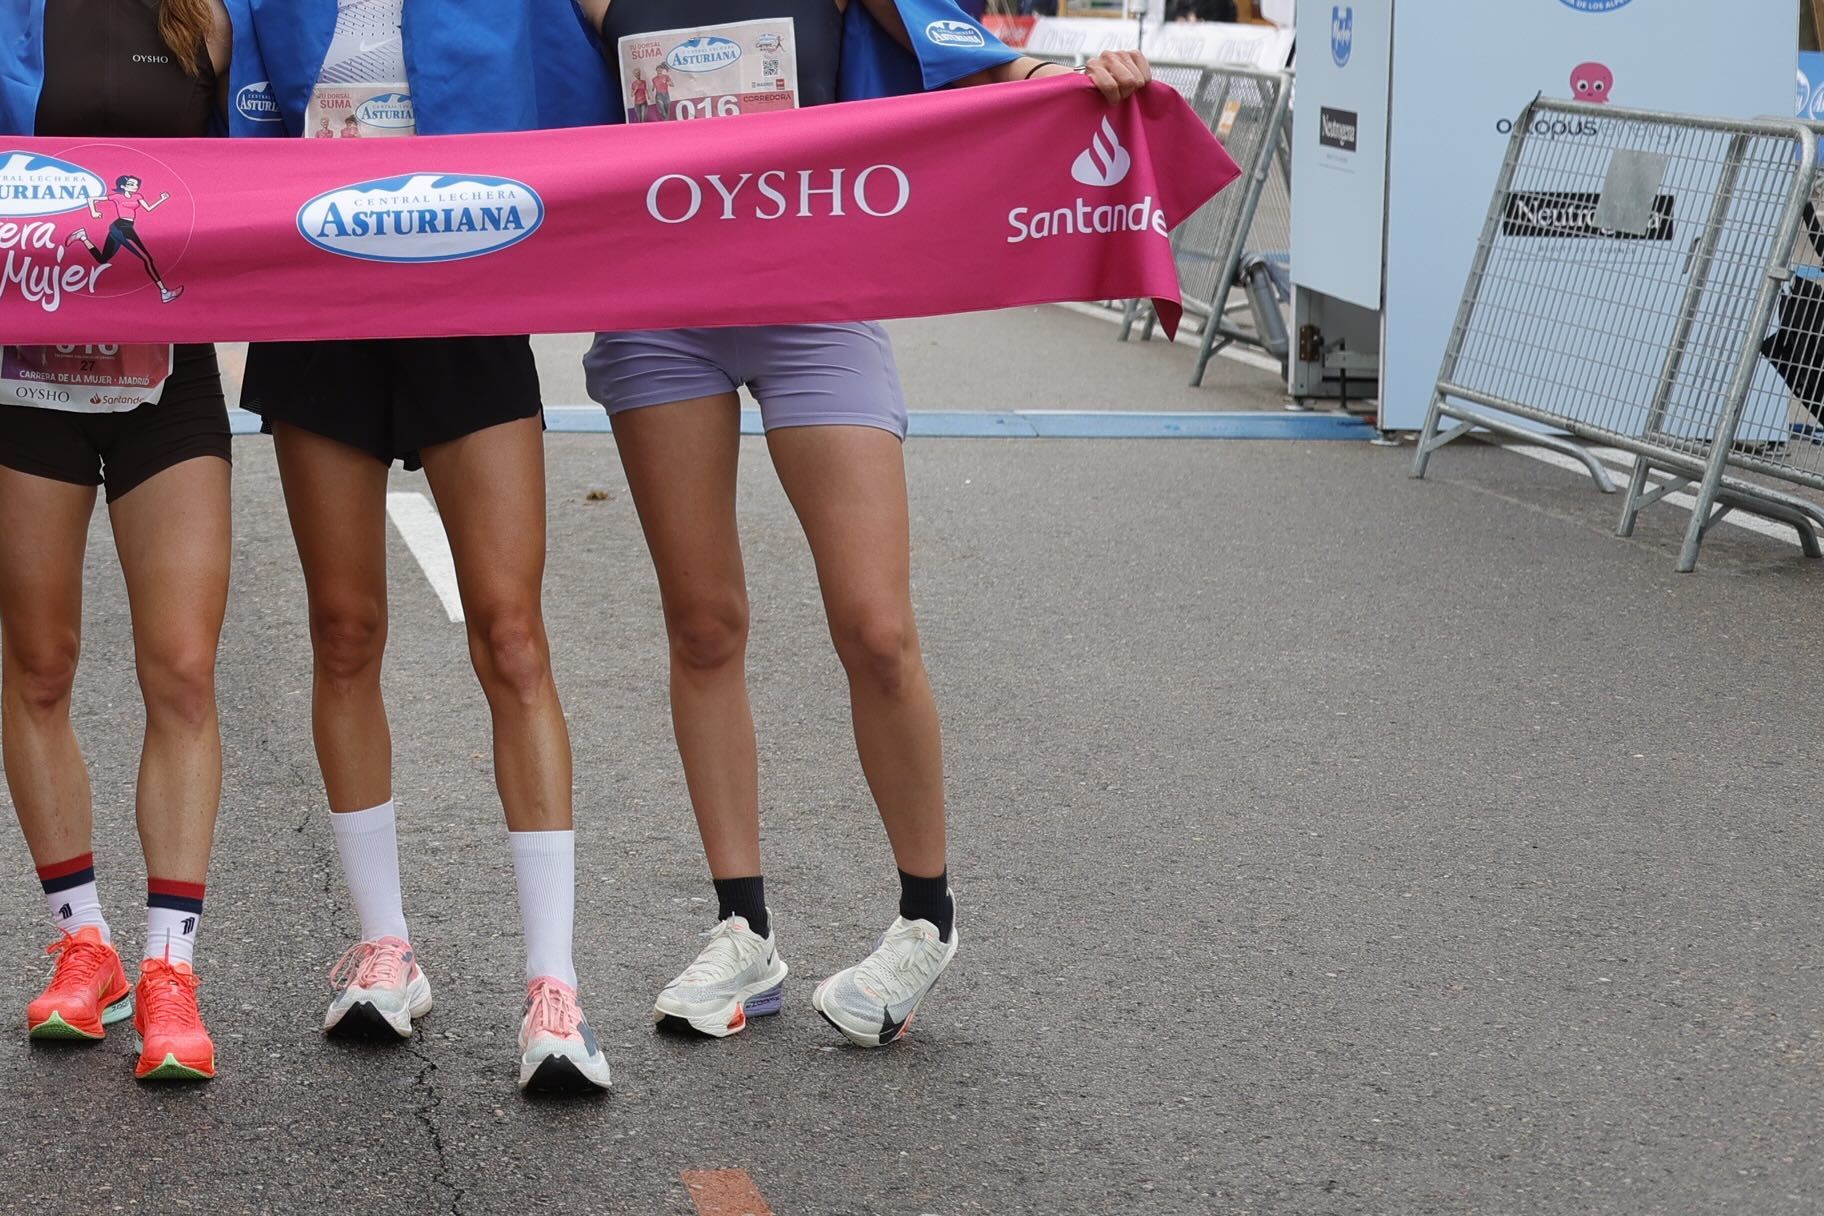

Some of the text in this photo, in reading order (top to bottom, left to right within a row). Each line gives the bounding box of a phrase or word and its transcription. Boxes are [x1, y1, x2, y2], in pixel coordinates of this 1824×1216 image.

[131, 53, 169, 64] OYSHO
[631, 48, 663, 60] SUMA
[672, 50, 738, 67] ASTURIANA
[240, 94, 278, 112] ASTURI
[320, 99, 352, 109] SUMA
[676, 95, 741, 120] 016
[361, 106, 414, 120] ASTURIA
[1321, 113, 1356, 147] Neutrogena
[29, 175, 87, 183] LECHERA
[353, 190, 517, 209] CENTRAL LECHERA
[645, 163, 911, 225] OYSHO
[316, 200, 526, 240] ASTURIANA
[1007, 194, 1168, 244] Santande
[1517, 200, 1663, 235] Neutroa
[80, 360, 96, 372] 27
[19, 370, 150, 386] CARRERA DE LA MUJER MADRID
[16, 386, 70, 403] OYSHO
